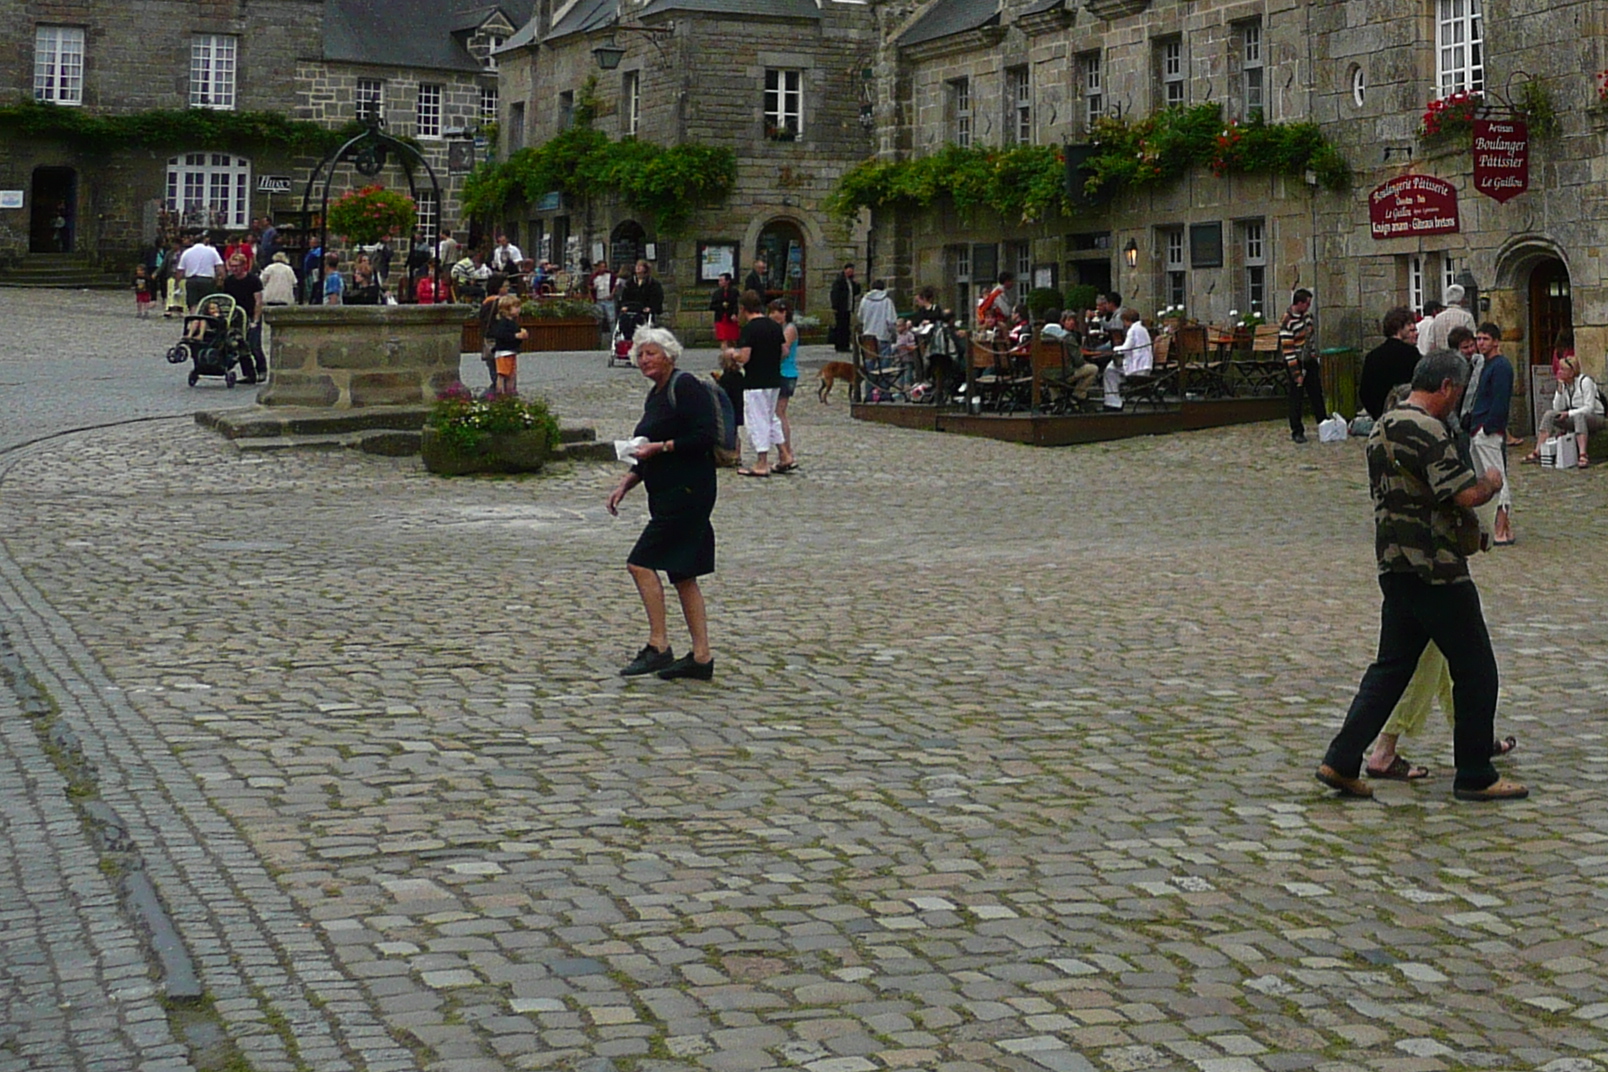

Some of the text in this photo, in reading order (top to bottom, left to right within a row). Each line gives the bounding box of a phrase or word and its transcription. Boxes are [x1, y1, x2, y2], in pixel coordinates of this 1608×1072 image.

[1488, 123, 1514, 133] Artisan
[1475, 136, 1526, 156] Boulanger
[1479, 154, 1524, 168] Pâtissier
[1481, 176, 1492, 187] Le
